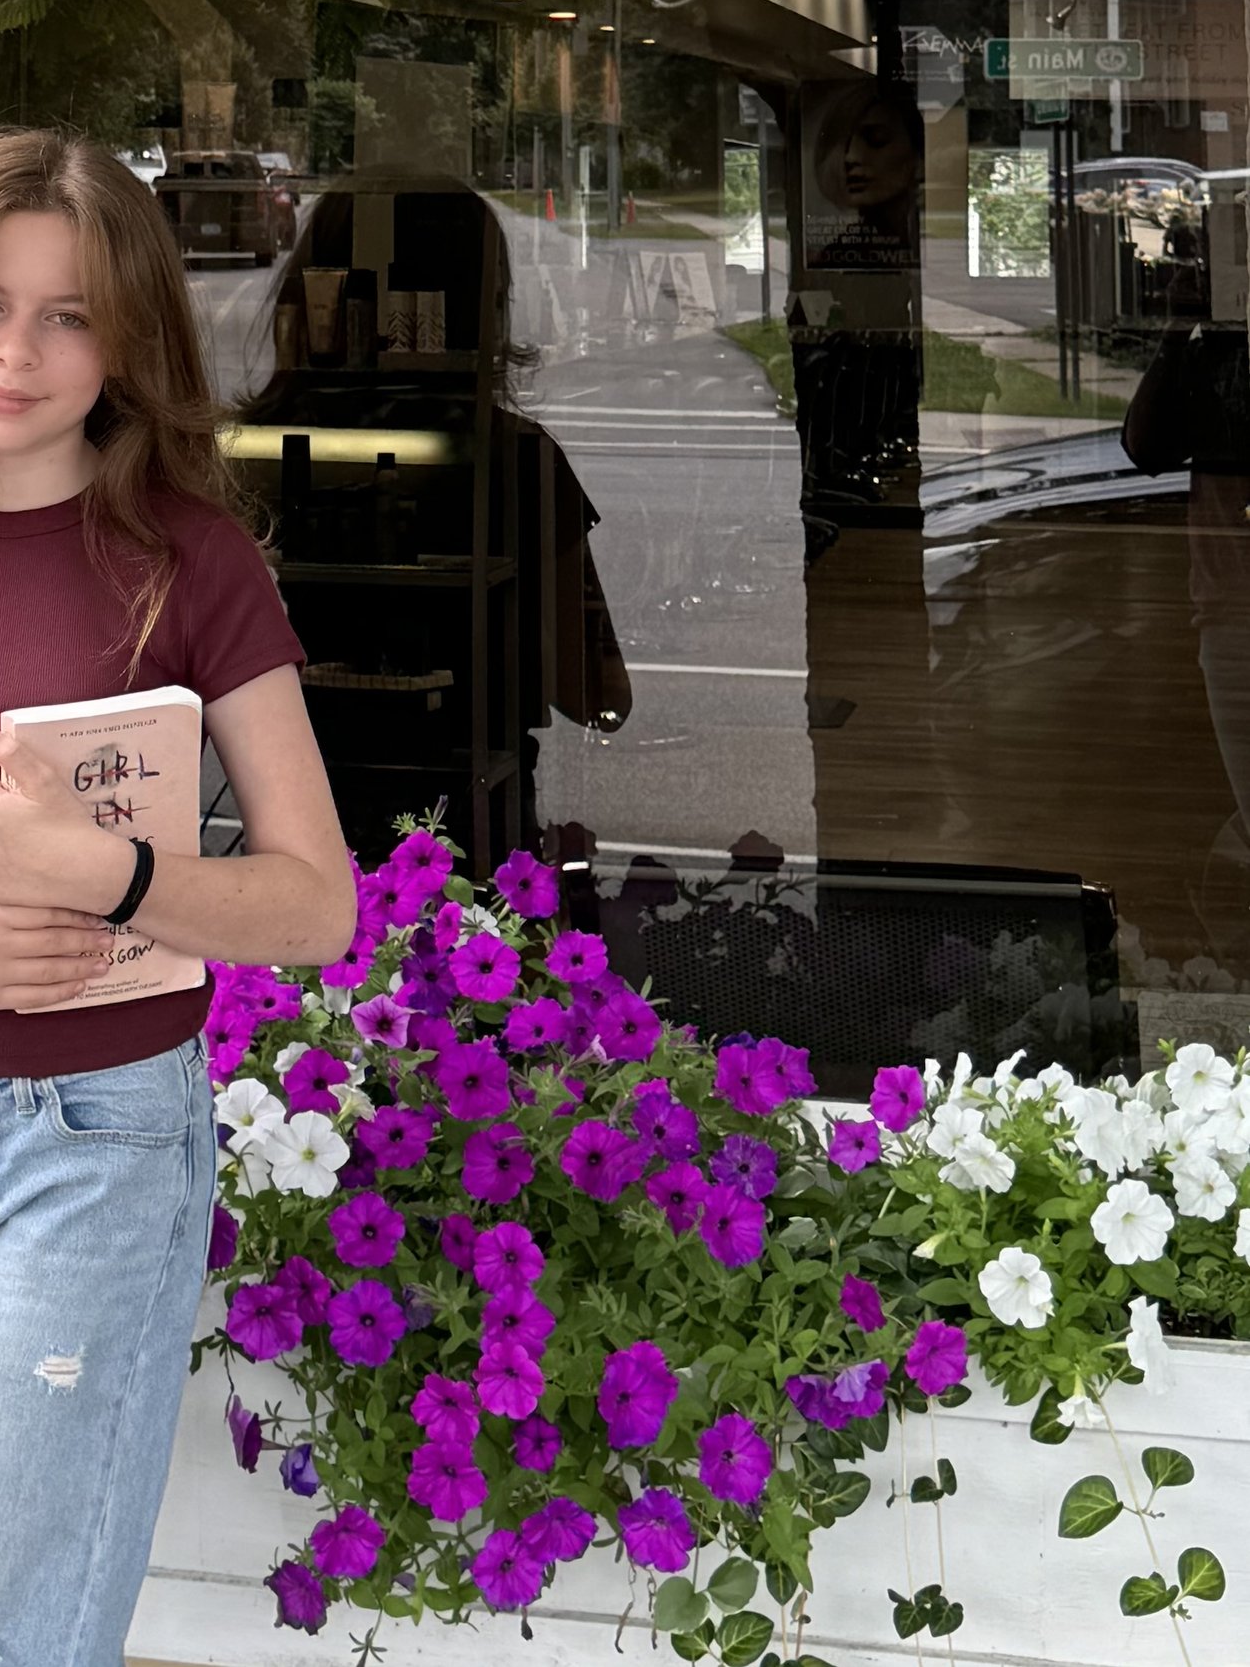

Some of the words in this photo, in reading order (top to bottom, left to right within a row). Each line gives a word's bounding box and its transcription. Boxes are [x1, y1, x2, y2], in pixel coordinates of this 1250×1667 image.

[832, 249, 919, 264] GOLDWEL
[75, 750, 160, 792] GIRL
[95, 793, 134, 827] IN
[80, 940, 155, 966] SGOW
